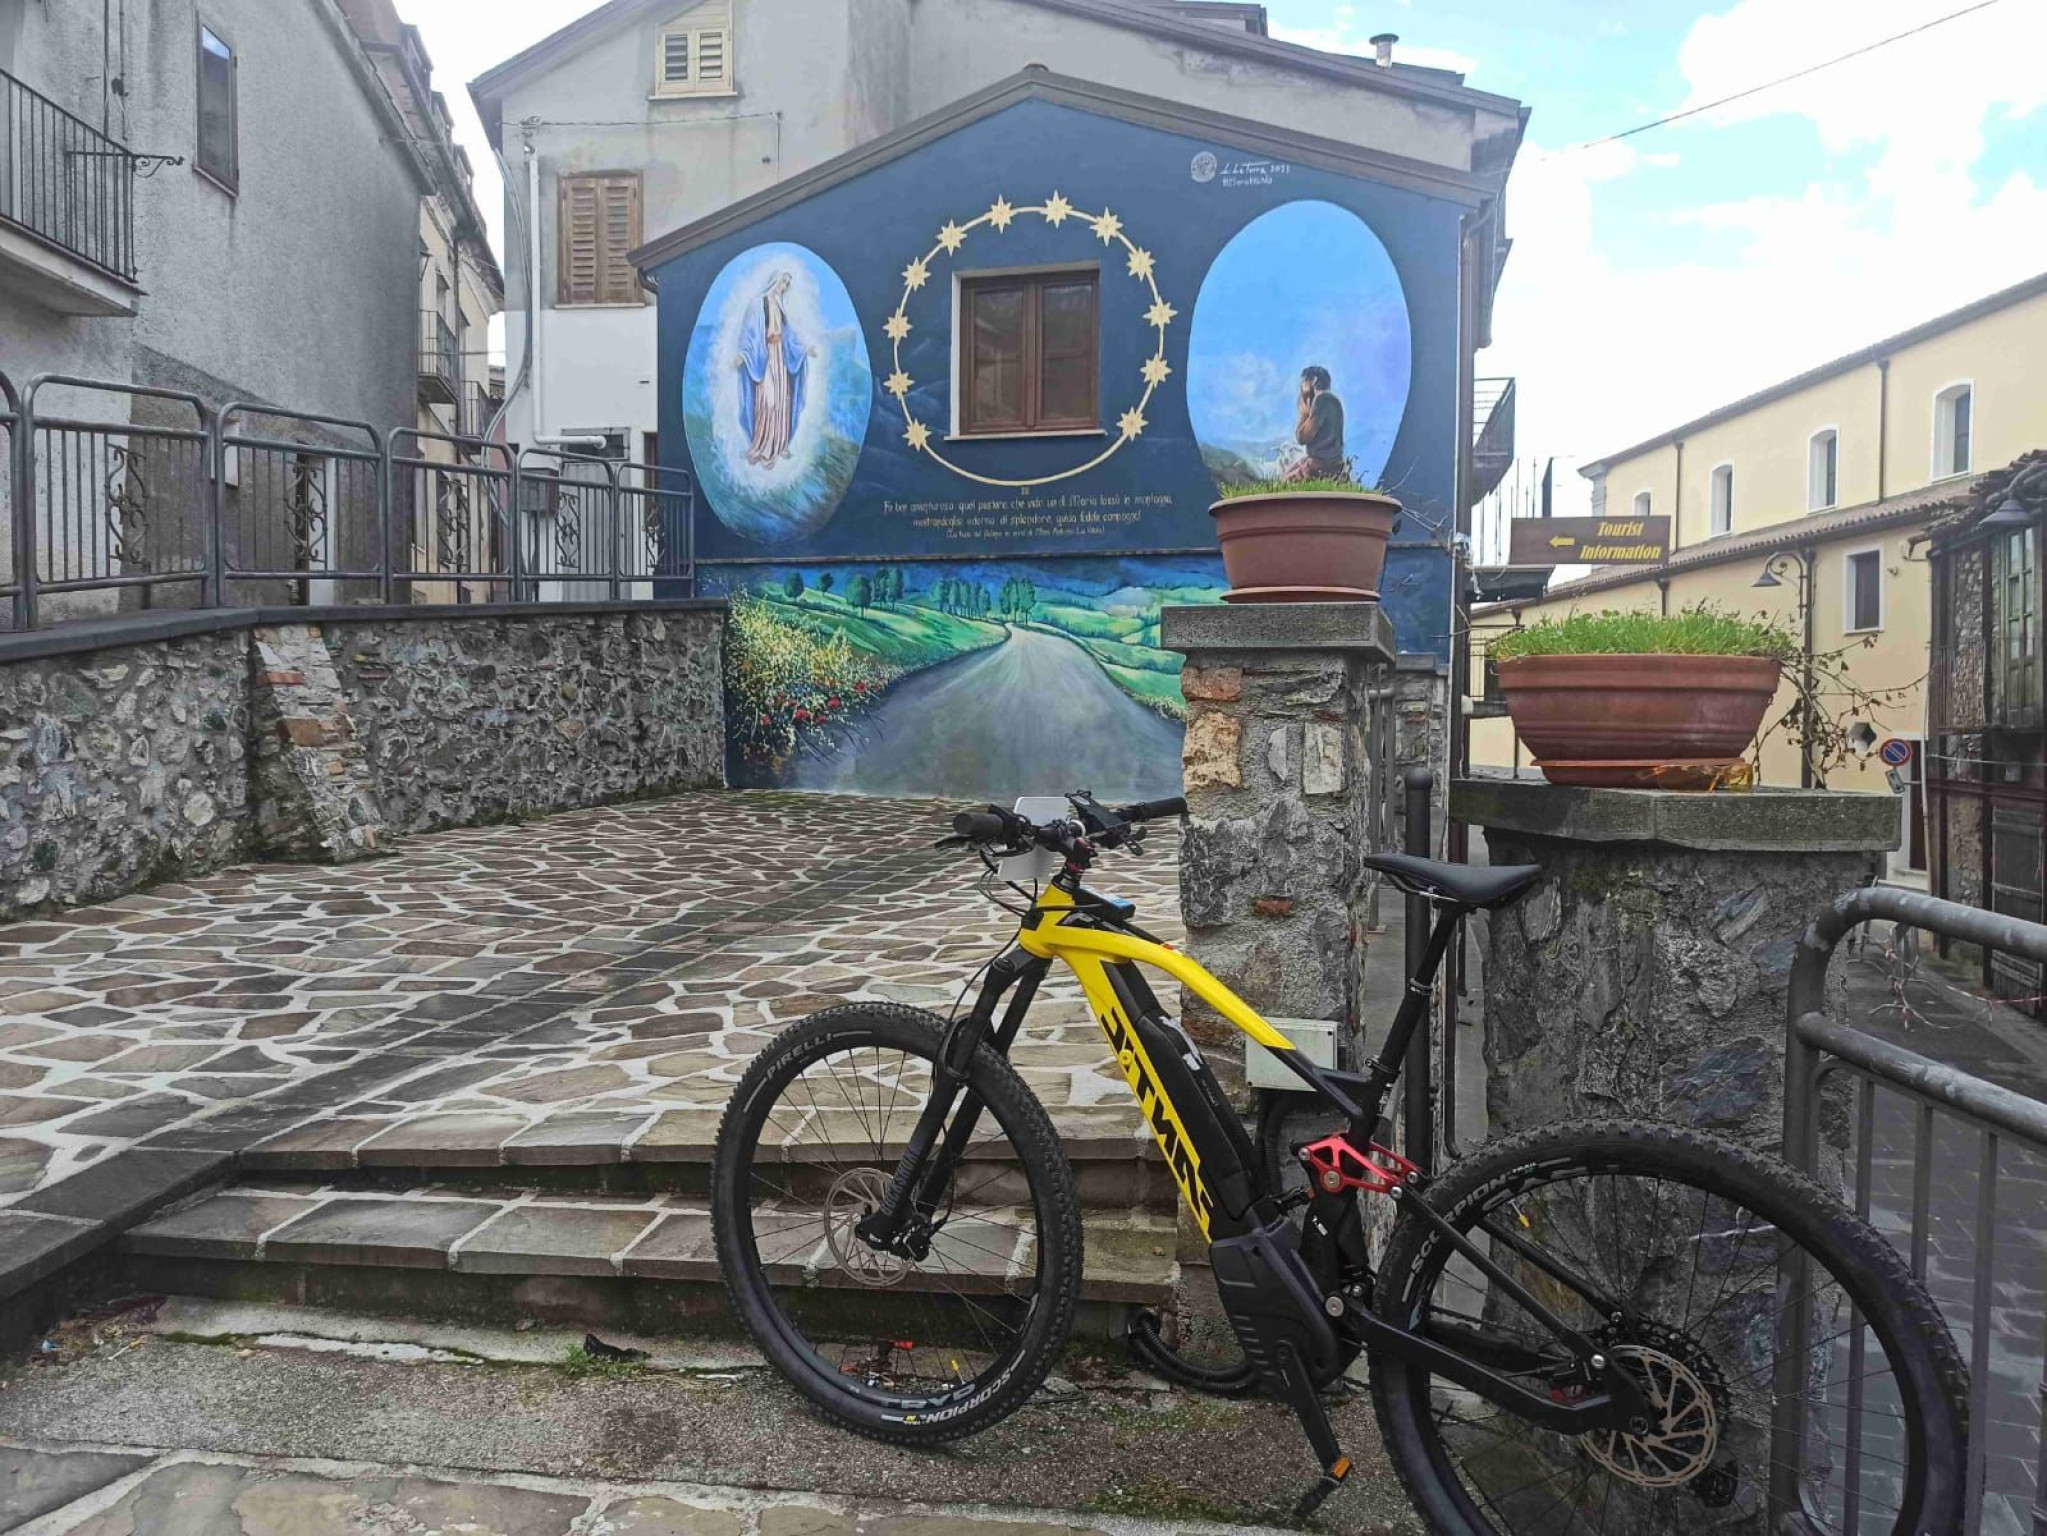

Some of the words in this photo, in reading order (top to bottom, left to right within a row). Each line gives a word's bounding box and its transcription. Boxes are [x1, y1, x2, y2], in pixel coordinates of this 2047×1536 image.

[1598, 521, 1644, 536] Tourist
[1580, 545, 1662, 560] Information
[767, 1033, 832, 1080] PIRELLI
[926, 1372, 1012, 1425] SCORPION
